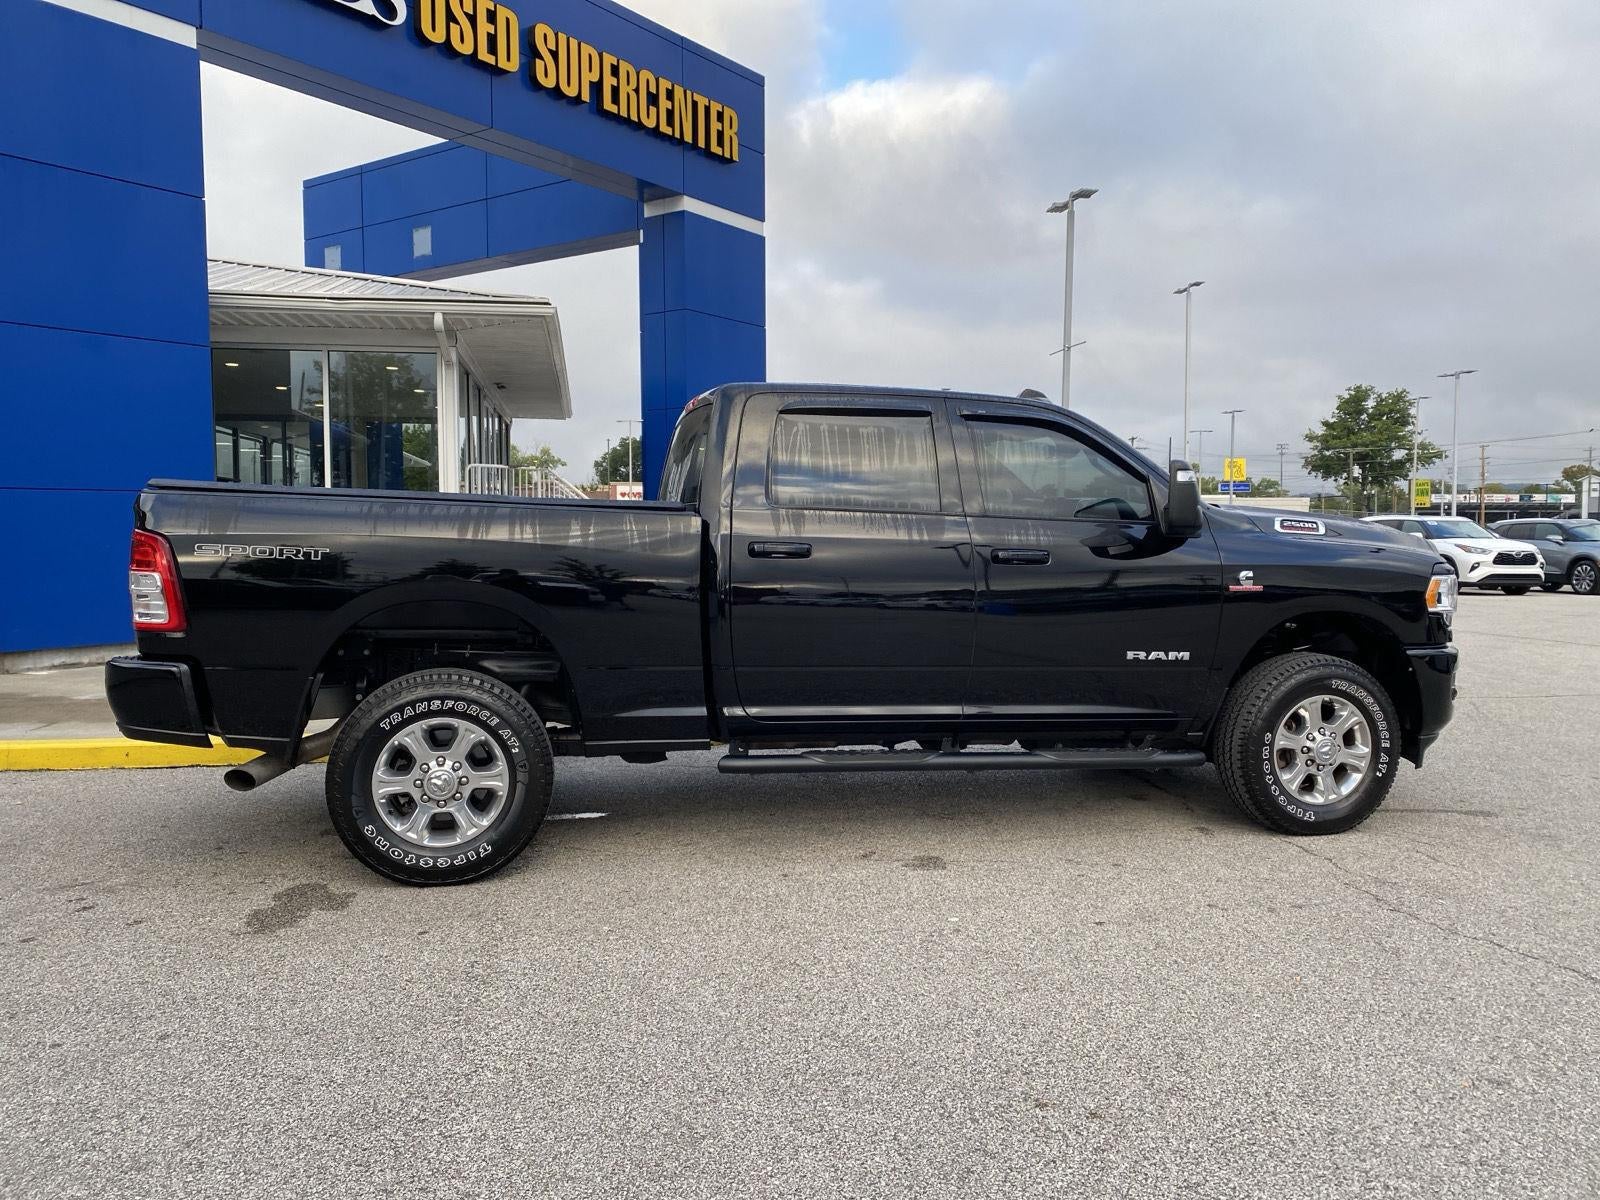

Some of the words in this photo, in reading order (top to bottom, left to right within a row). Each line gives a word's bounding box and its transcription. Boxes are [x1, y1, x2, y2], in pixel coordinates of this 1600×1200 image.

[419, 0, 520, 73] USED
[533, 22, 740, 162] SUPERCENTER
[1282, 520, 1318, 528] 2500
[194, 543, 330, 560] SPORT
[1126, 650, 1190, 660] RAM
[379, 700, 500, 731] TRANSFORCE
[1331, 679, 1390, 748] TRANSFORCE
